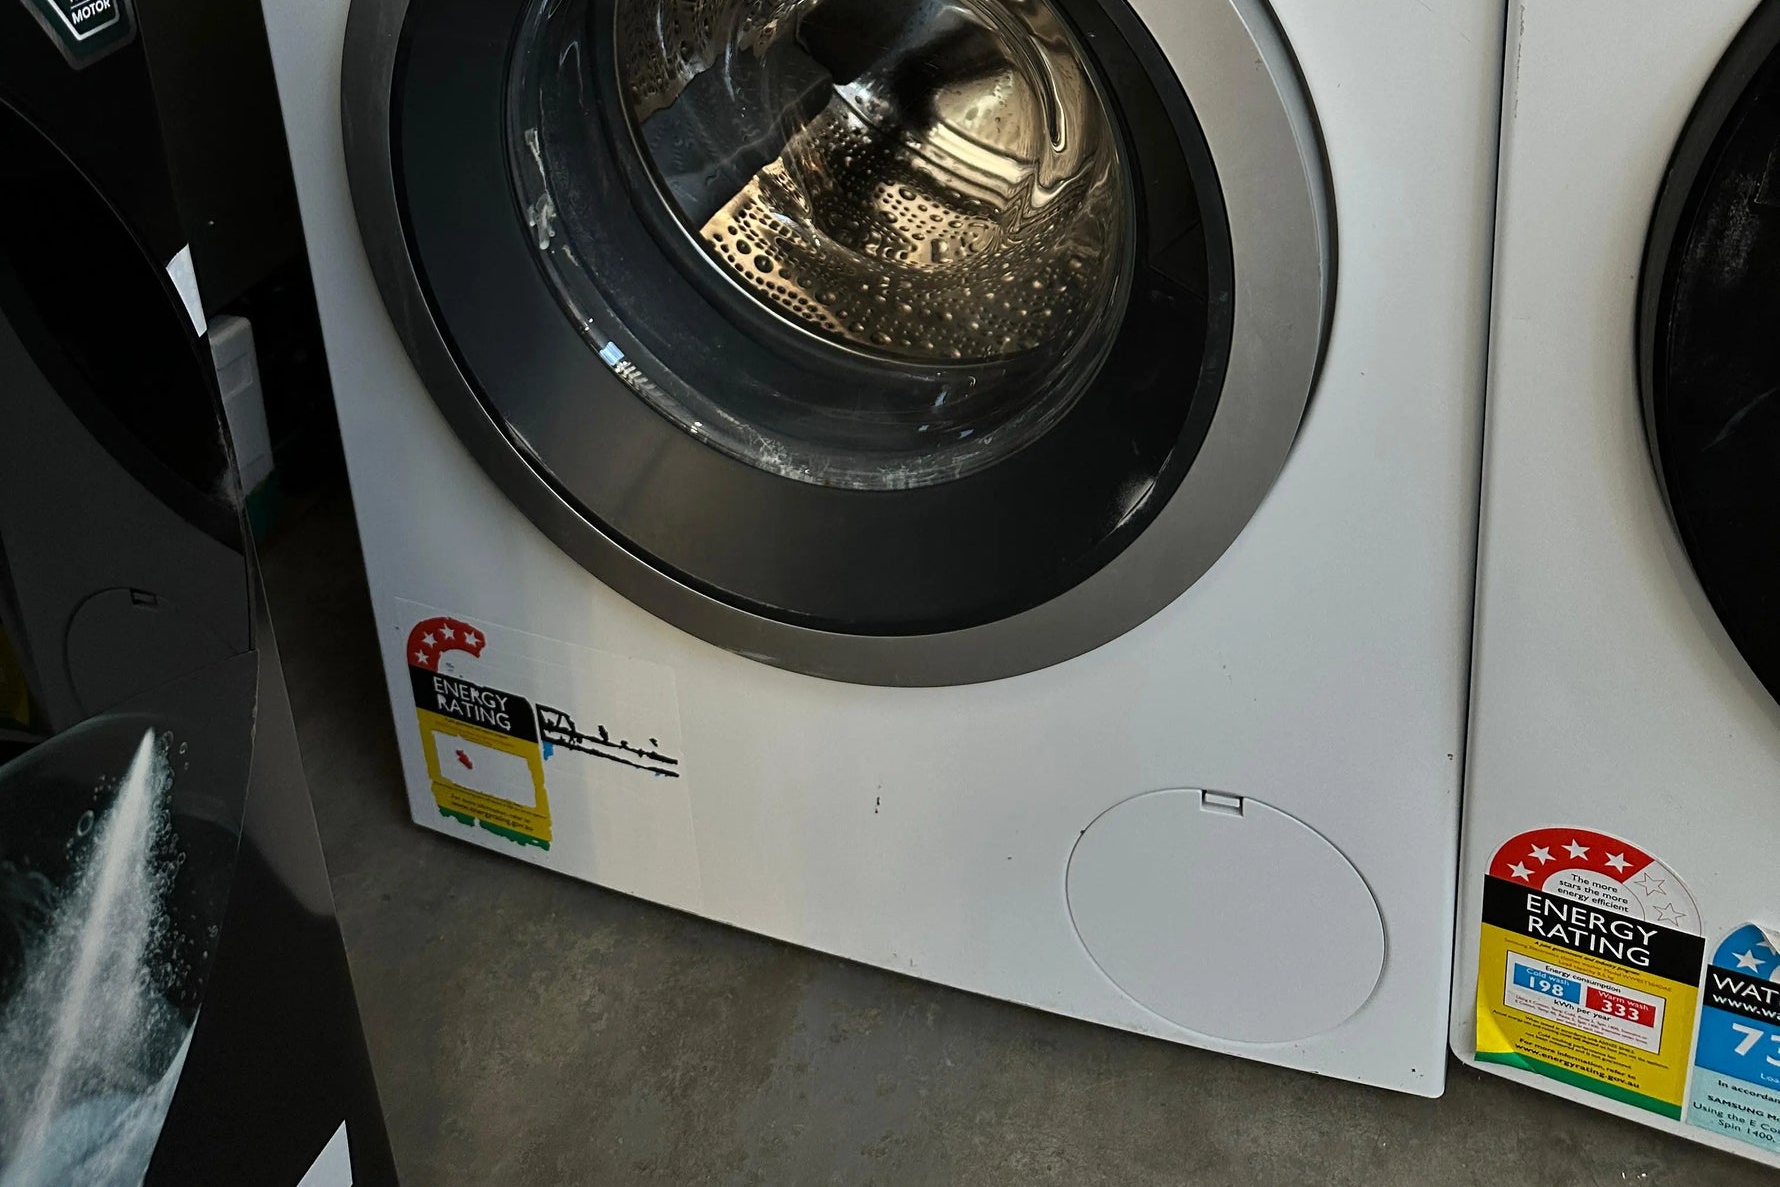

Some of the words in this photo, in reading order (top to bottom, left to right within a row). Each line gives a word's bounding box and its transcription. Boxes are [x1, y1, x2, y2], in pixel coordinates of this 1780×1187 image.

[434, 676, 508, 711] ENERGY
[437, 695, 511, 731] RATING
[1559, 879, 1581, 892] stars
[1584, 885, 1600, 897] the
[1602, 892, 1629, 905] more
[1571, 873, 1590, 885] The
[1592, 881, 1618, 893] more
[1557, 887, 1589, 902] energy
[1592, 896, 1629, 913] efficient
[1526, 893, 1658, 946] ENERGY
[1528, 915, 1650, 967] RATING
[1526, 966, 1546, 978] Cold
[1548, 973, 1569, 986] wash
[1529, 975, 1564, 997] 198
[1545, 964, 1570, 978] Energy
[1572, 973, 1621, 993] consumption
[1554, 998, 1574, 1009] kWh
[1576, 1007, 1589, 1015] per
[1593, 1012, 1610, 1022] year
[1597, 989, 1624, 1003] Warm
[1627, 999, 1649, 1011] wash
[1601, 998, 1639, 1021] 333
[1515, 1044, 1640, 1089] www.energyrating.gov.au
[1519, 1037, 1532, 1045] For
[1534, 1044, 1555, 1053] more
[1606, 1067, 1625, 1076] refer
[1718, 1080, 1728, 1088] In
[1693, 1101, 1723, 1118] Using
[1727, 1113, 1745, 1123] the
[1750, 1119, 1756, 1127] E
[1707, 1095, 1764, 1117] SAMSUNG
[1718, 1119, 1741, 1132] Spin
